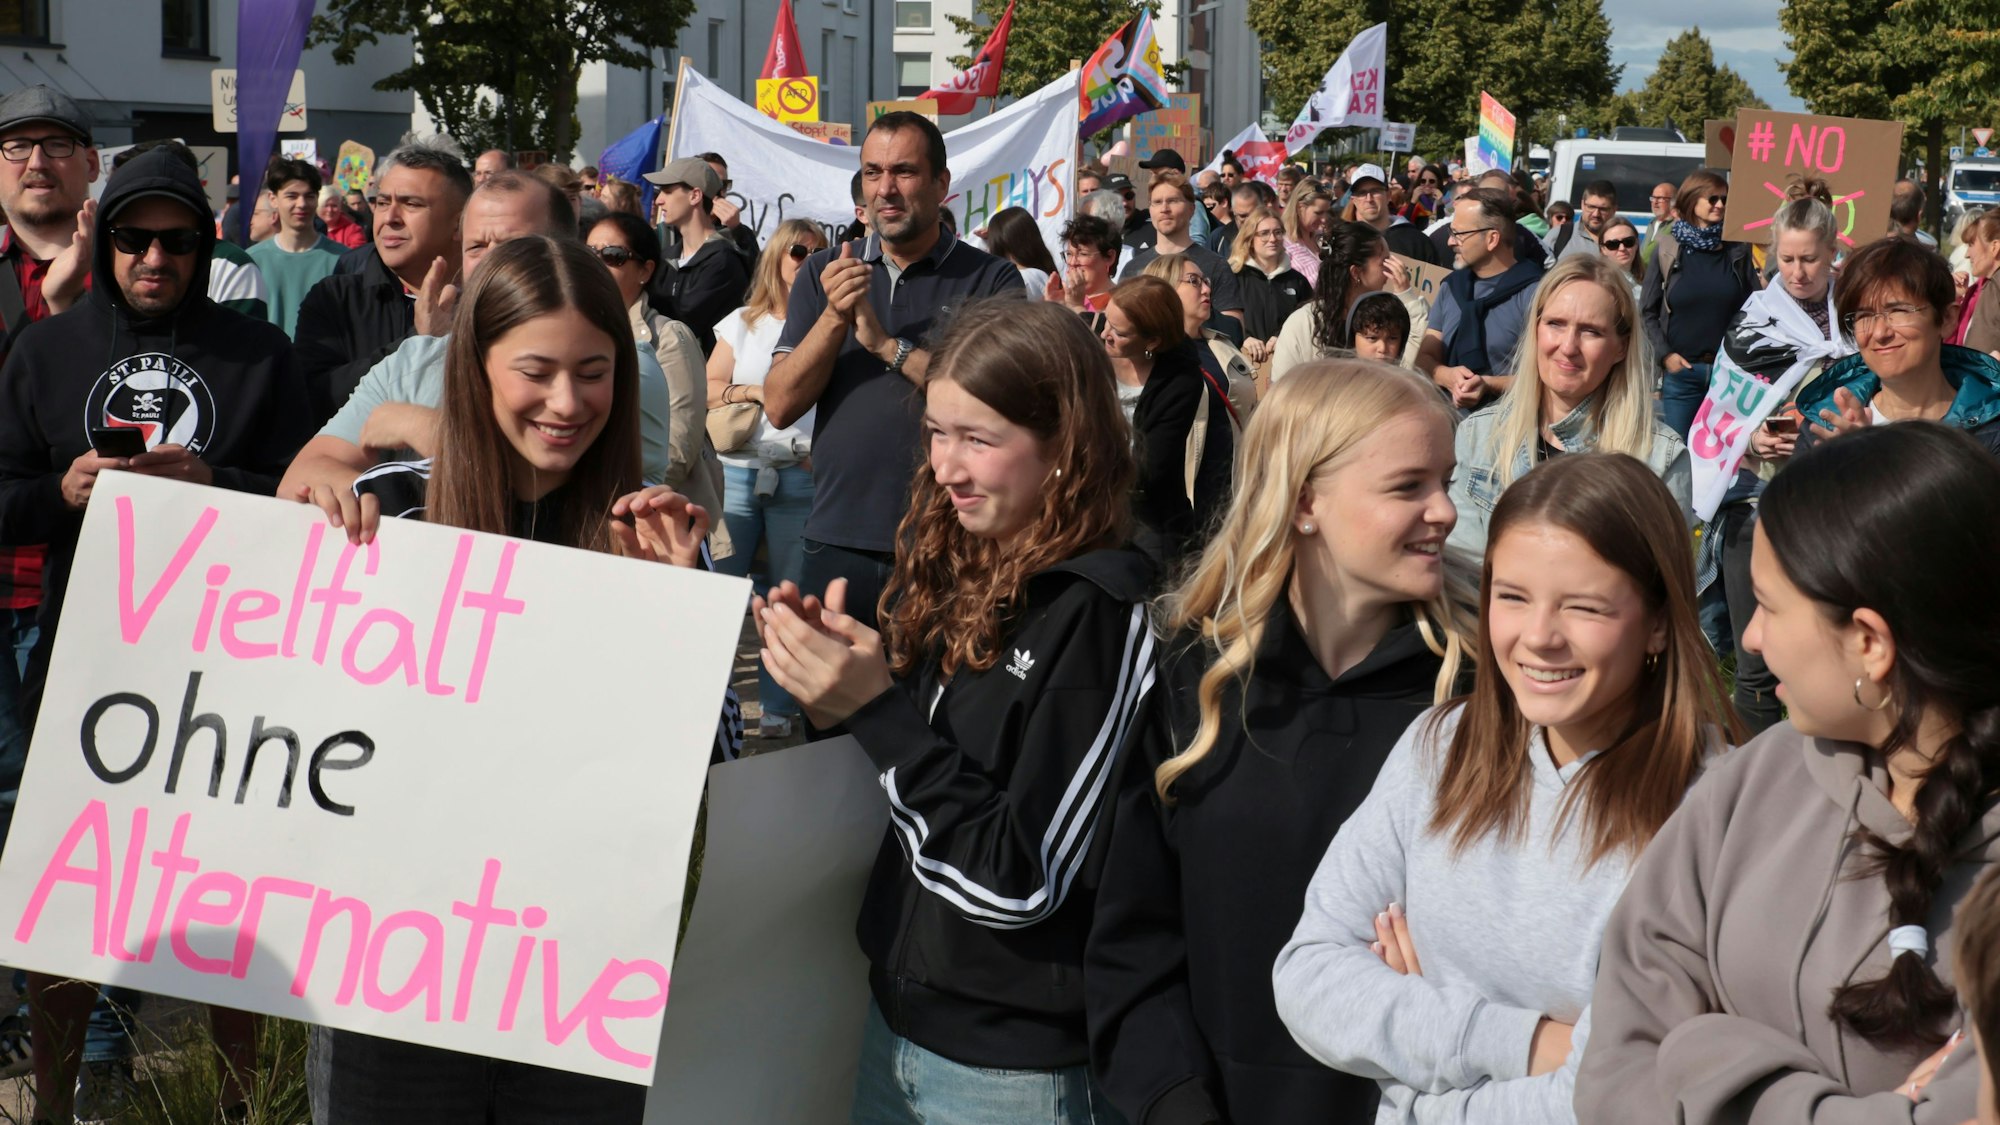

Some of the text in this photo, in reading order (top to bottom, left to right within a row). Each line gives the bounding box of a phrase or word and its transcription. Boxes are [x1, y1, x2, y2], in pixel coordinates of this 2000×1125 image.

[833, 127, 849, 138] die
[1784, 123, 1846, 173] NO
[108, 361, 137, 386] ST.
[115, 495, 526, 704] Vielfalt
[80, 671, 376, 816] ohne
[14, 799, 671, 1069] Alternative
